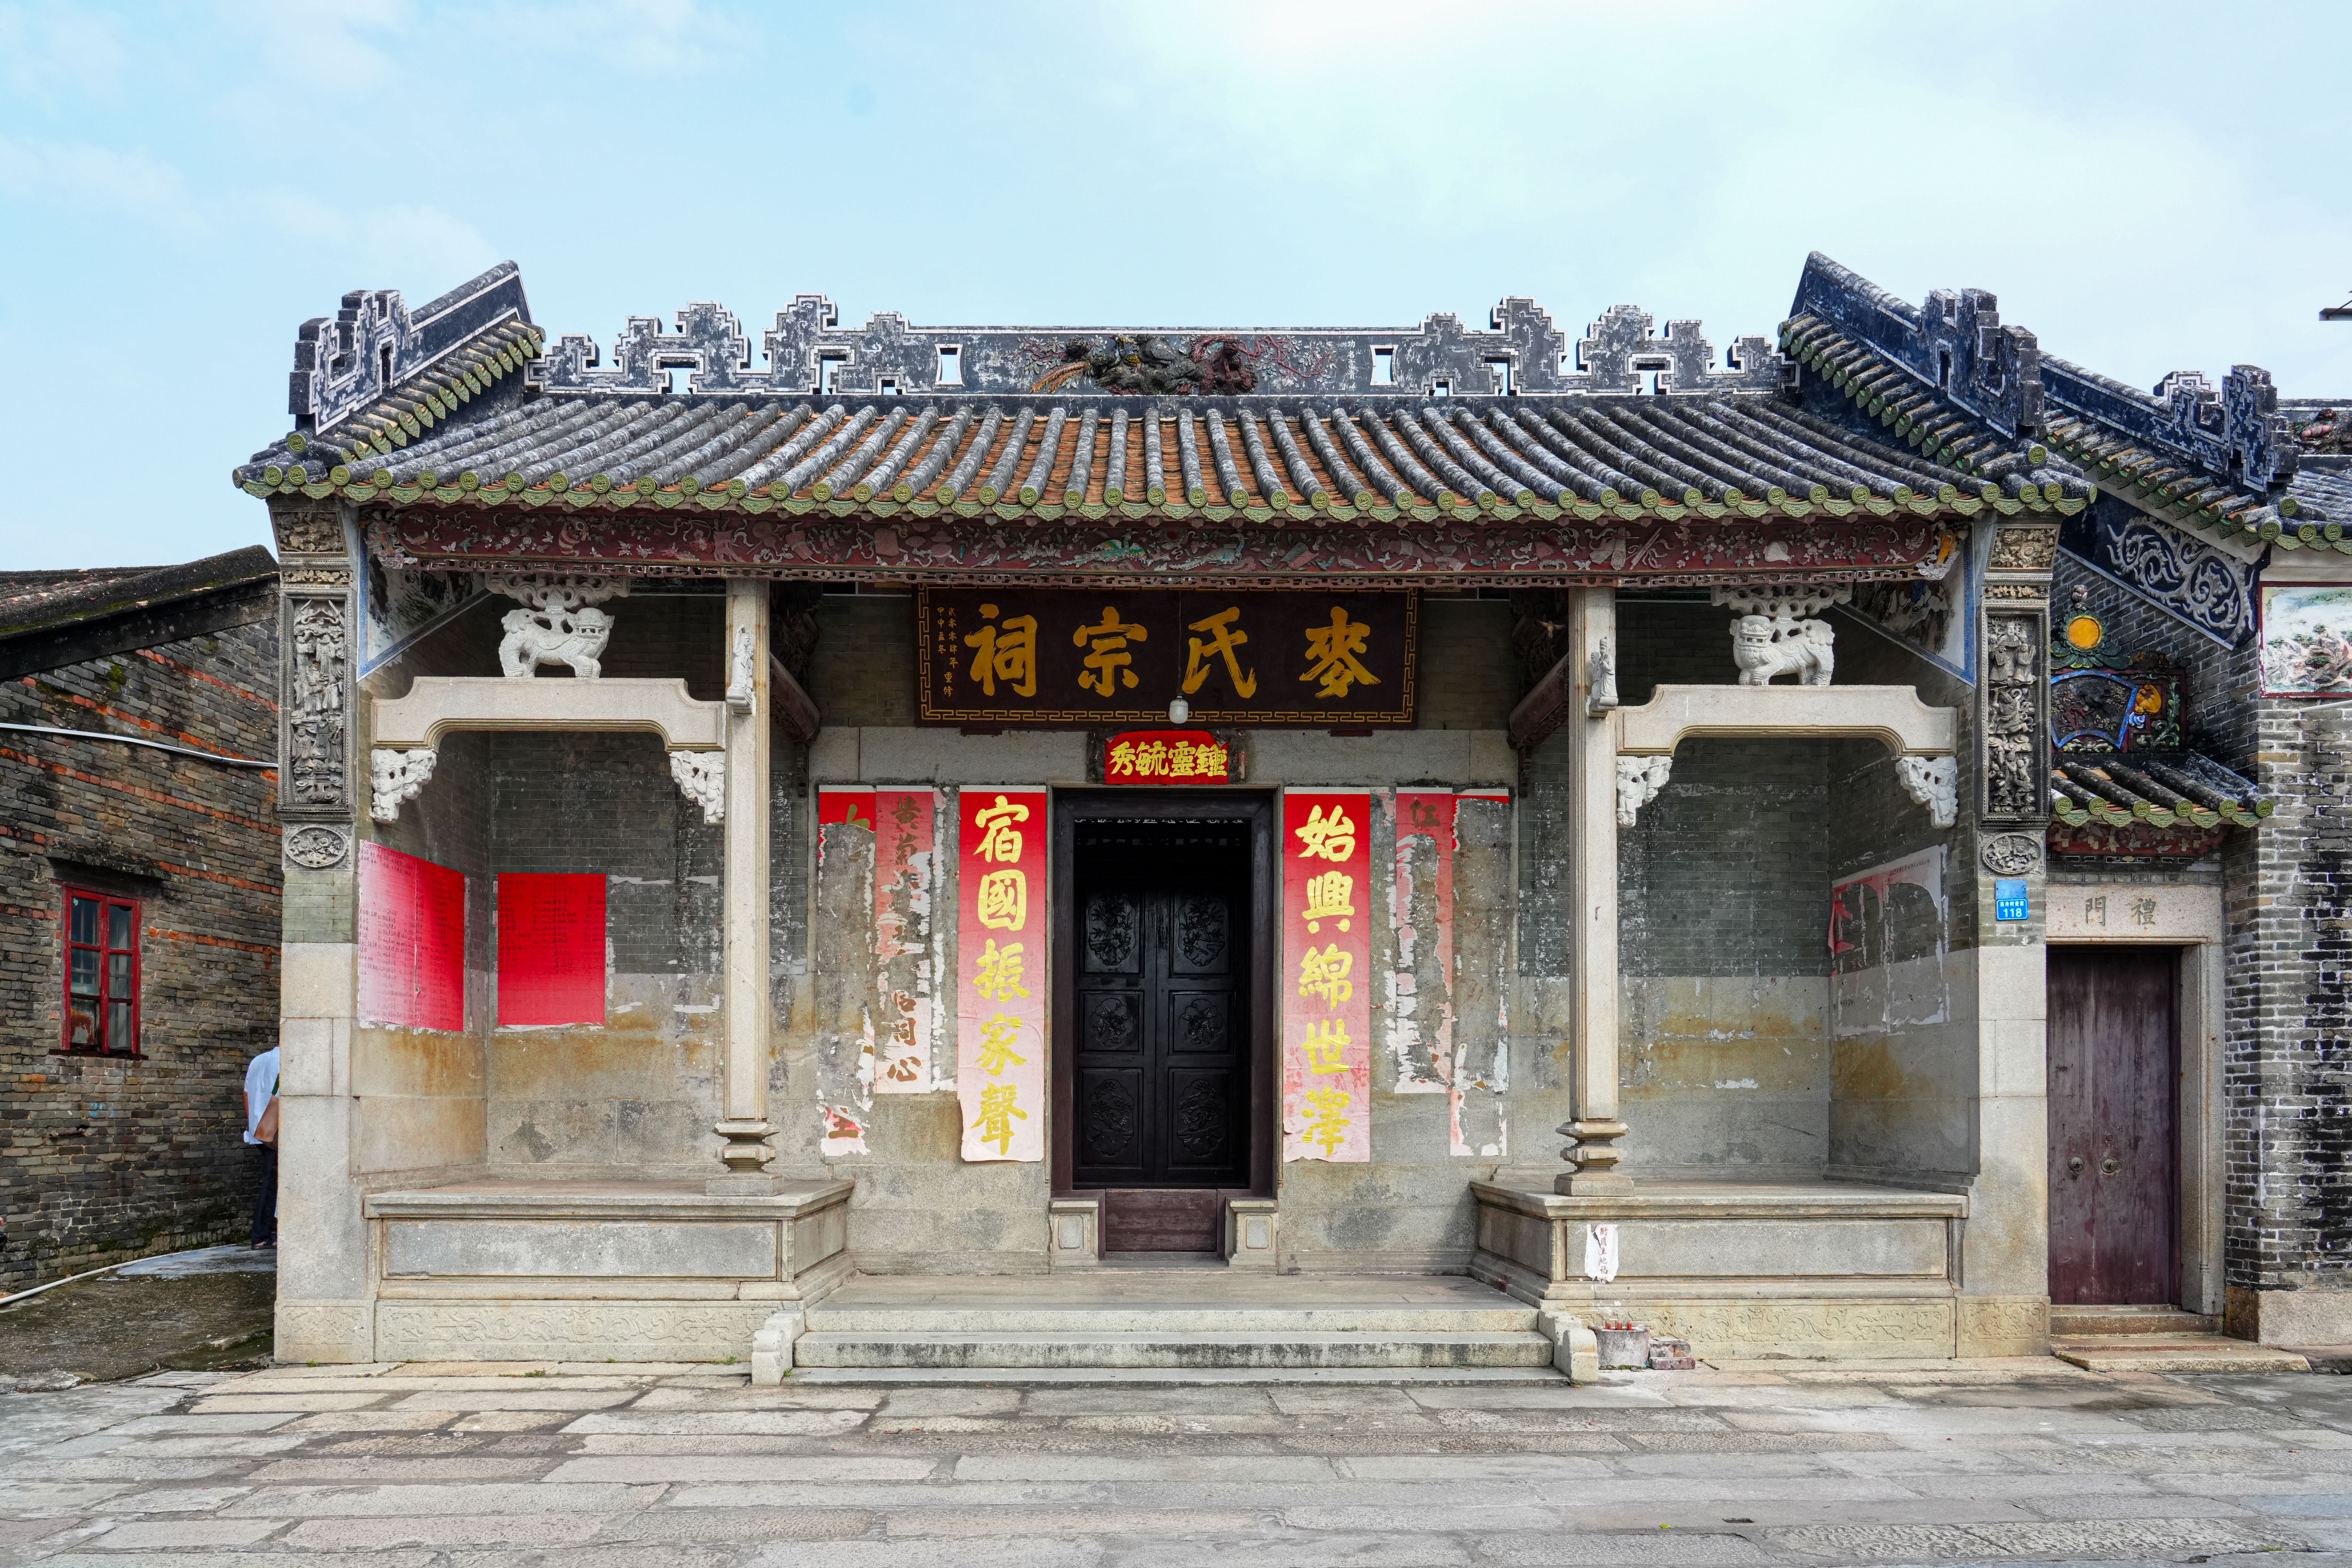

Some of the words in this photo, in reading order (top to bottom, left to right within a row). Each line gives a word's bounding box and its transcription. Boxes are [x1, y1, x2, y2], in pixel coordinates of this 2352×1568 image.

[937, 607, 946, 654] 甲申孟冬
[943, 671, 953, 697] 重修
[2003, 908, 2022, 917] 118
[2086, 896, 2156, 926] 禮門
[971, 795, 1031, 1155] 宿國振家聲
[1295, 805, 1355, 1156] 始興綿世澤
